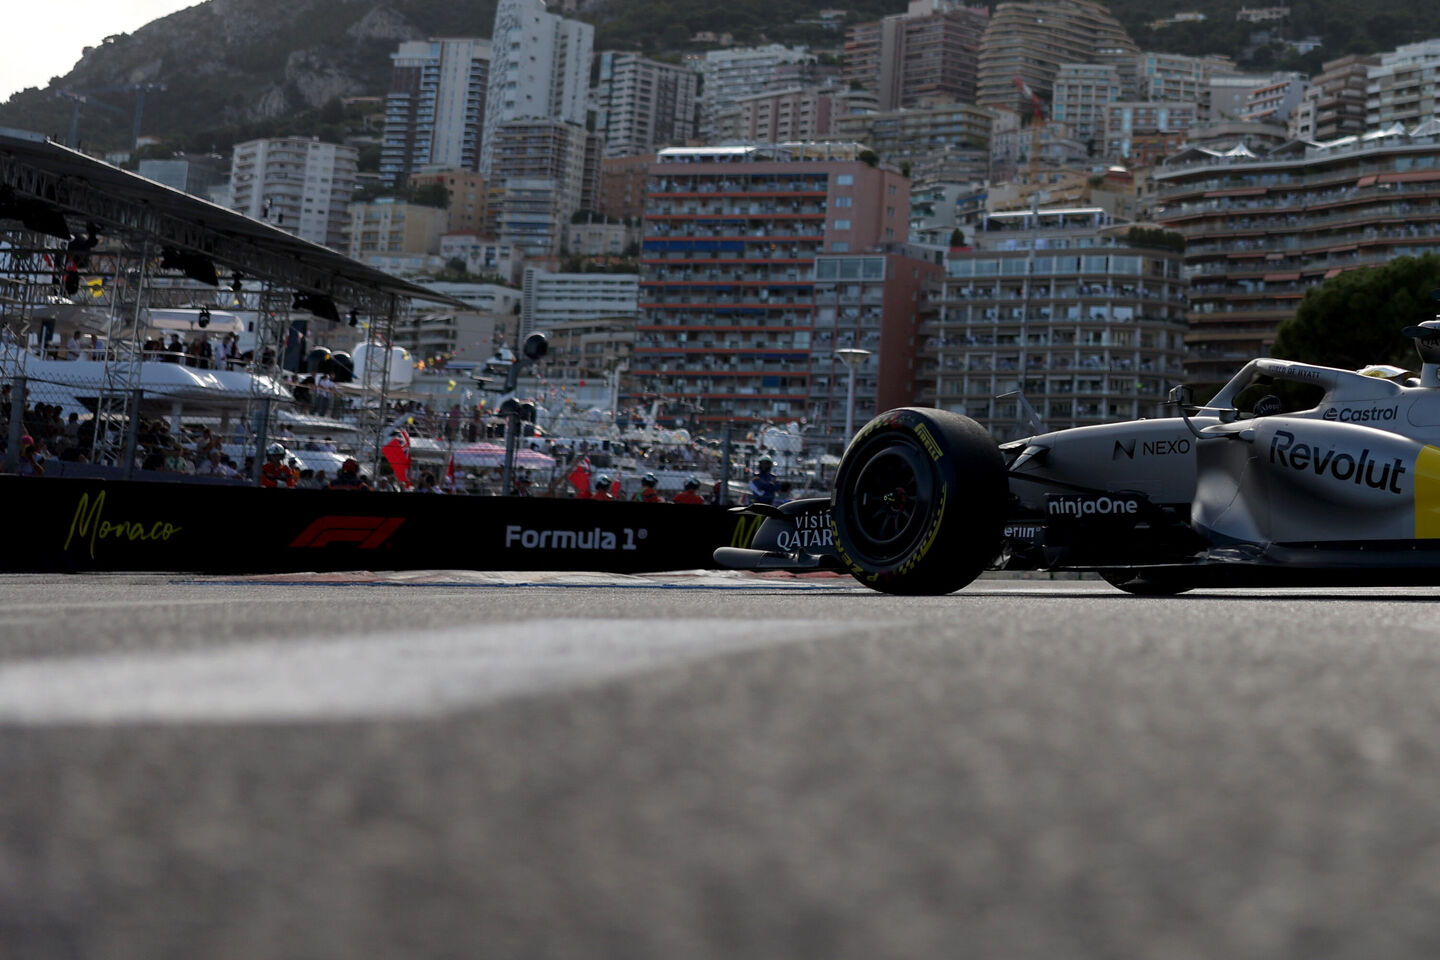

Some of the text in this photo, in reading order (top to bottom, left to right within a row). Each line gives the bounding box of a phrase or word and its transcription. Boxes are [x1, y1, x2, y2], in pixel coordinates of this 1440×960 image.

[1339, 404, 1399, 423] Castrol
[1142, 439, 1191, 456] NEXO
[1269, 429, 1407, 495] Revolut
[794, 509, 832, 529] visit
[1048, 496, 1138, 519] ninjaOne
[63, 489, 183, 560] Monaco
[504, 524, 617, 551] Formula
[776, 528, 834, 552] QATAR
